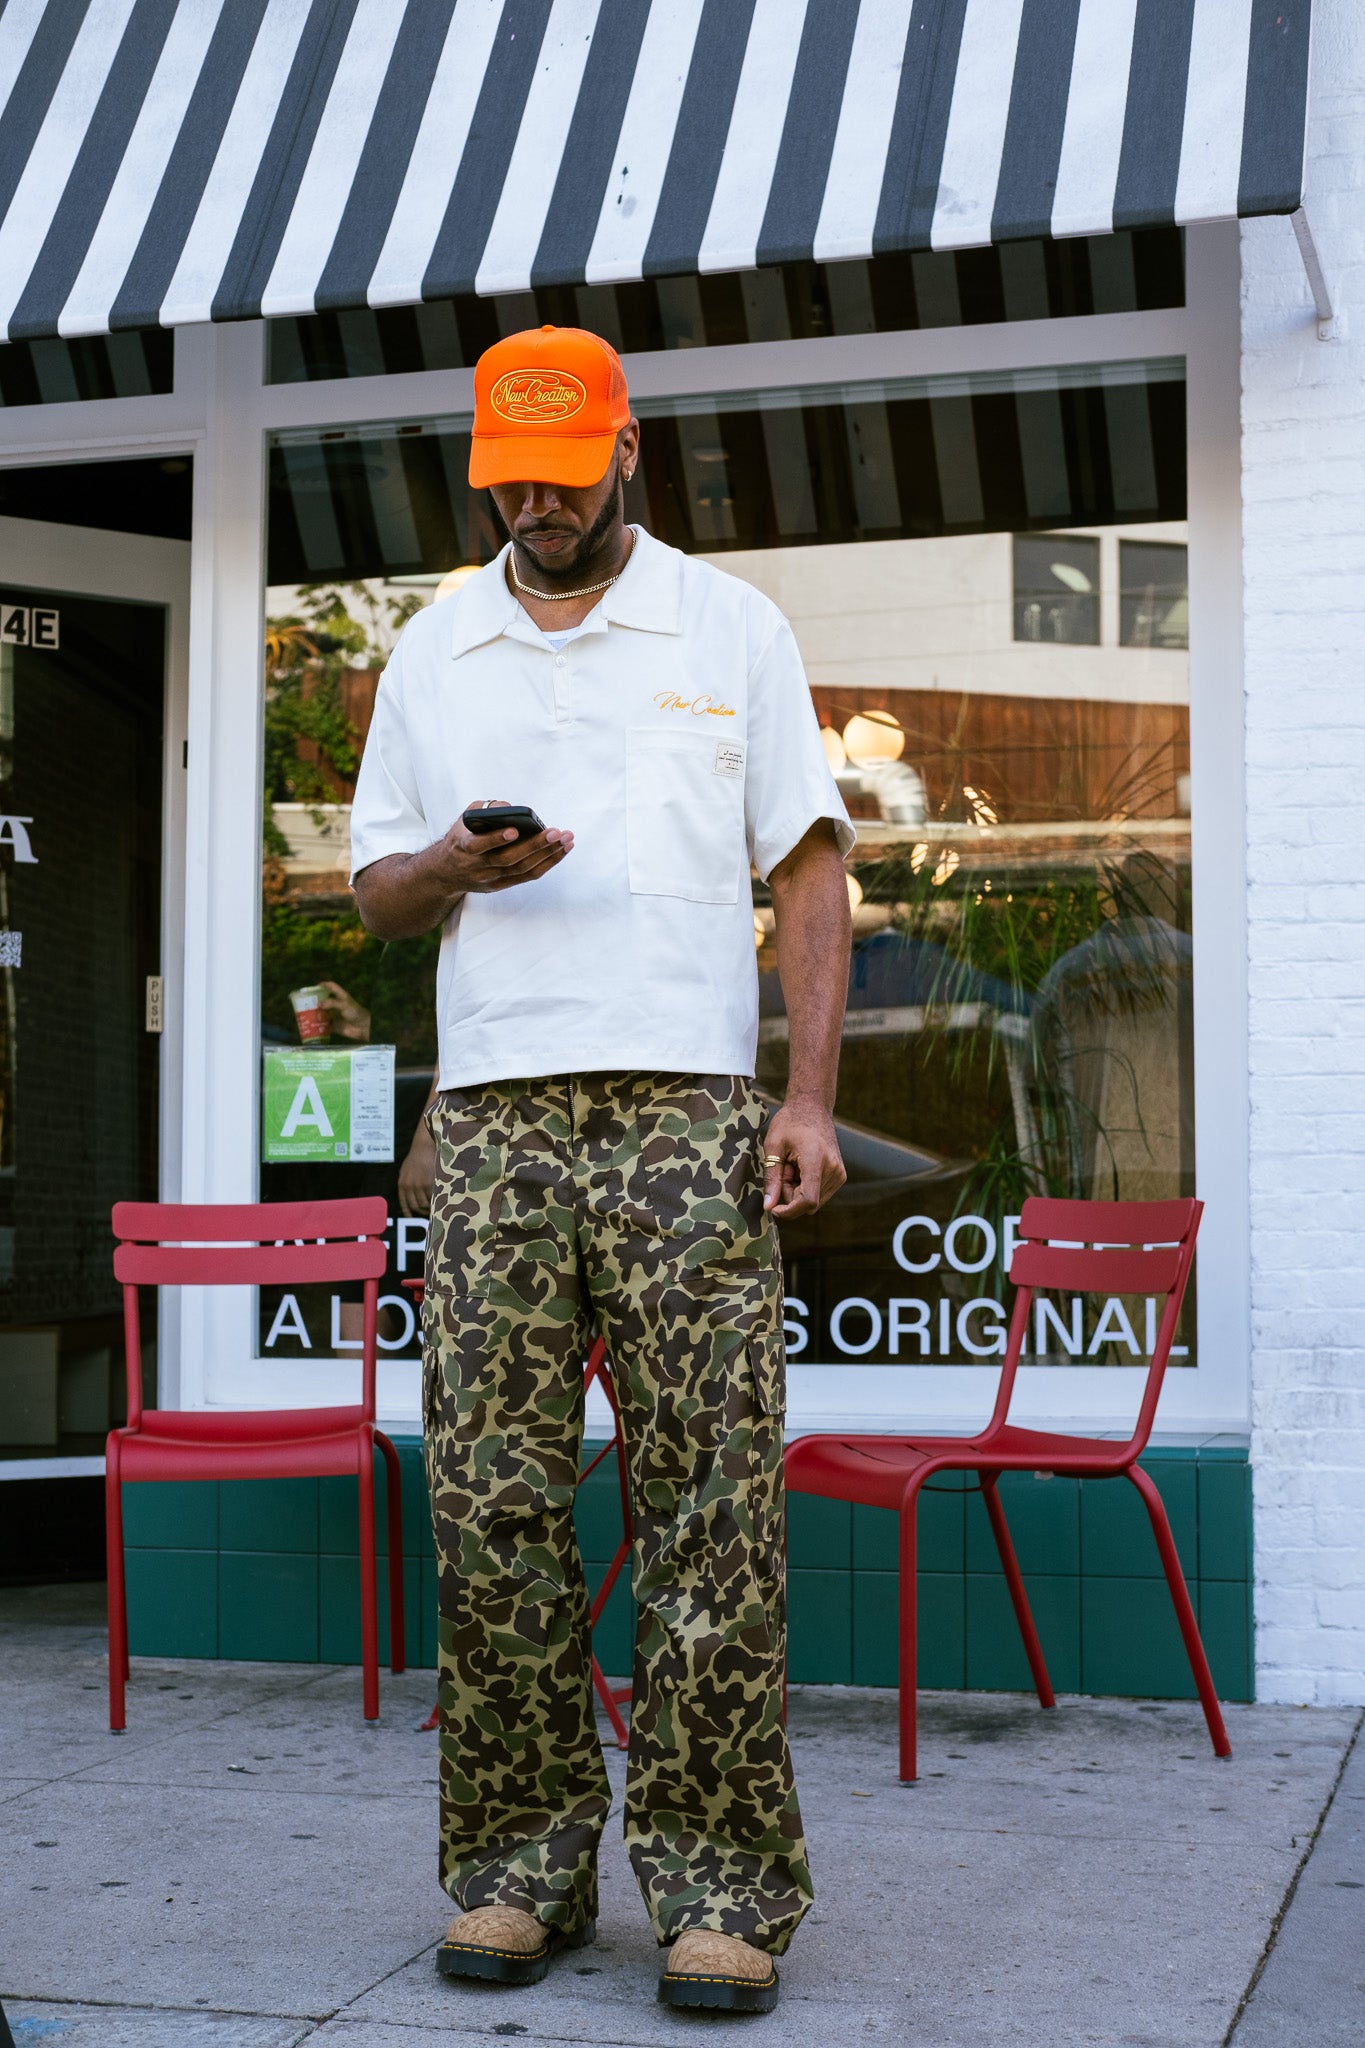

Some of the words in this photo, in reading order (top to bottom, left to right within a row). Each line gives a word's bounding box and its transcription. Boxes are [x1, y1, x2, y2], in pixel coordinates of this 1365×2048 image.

[495, 379, 525, 405] New
[517, 375, 579, 404] Creation
[653, 691, 690, 711] New
[151, 980, 159, 1028] PUSH
[280, 1075, 335, 1137] A
[892, 1215, 1182, 1274] COF
[265, 1294, 312, 1349] A
[331, 1294, 424, 1350] LO
[829, 1297, 1190, 1356] ORIGNAL
